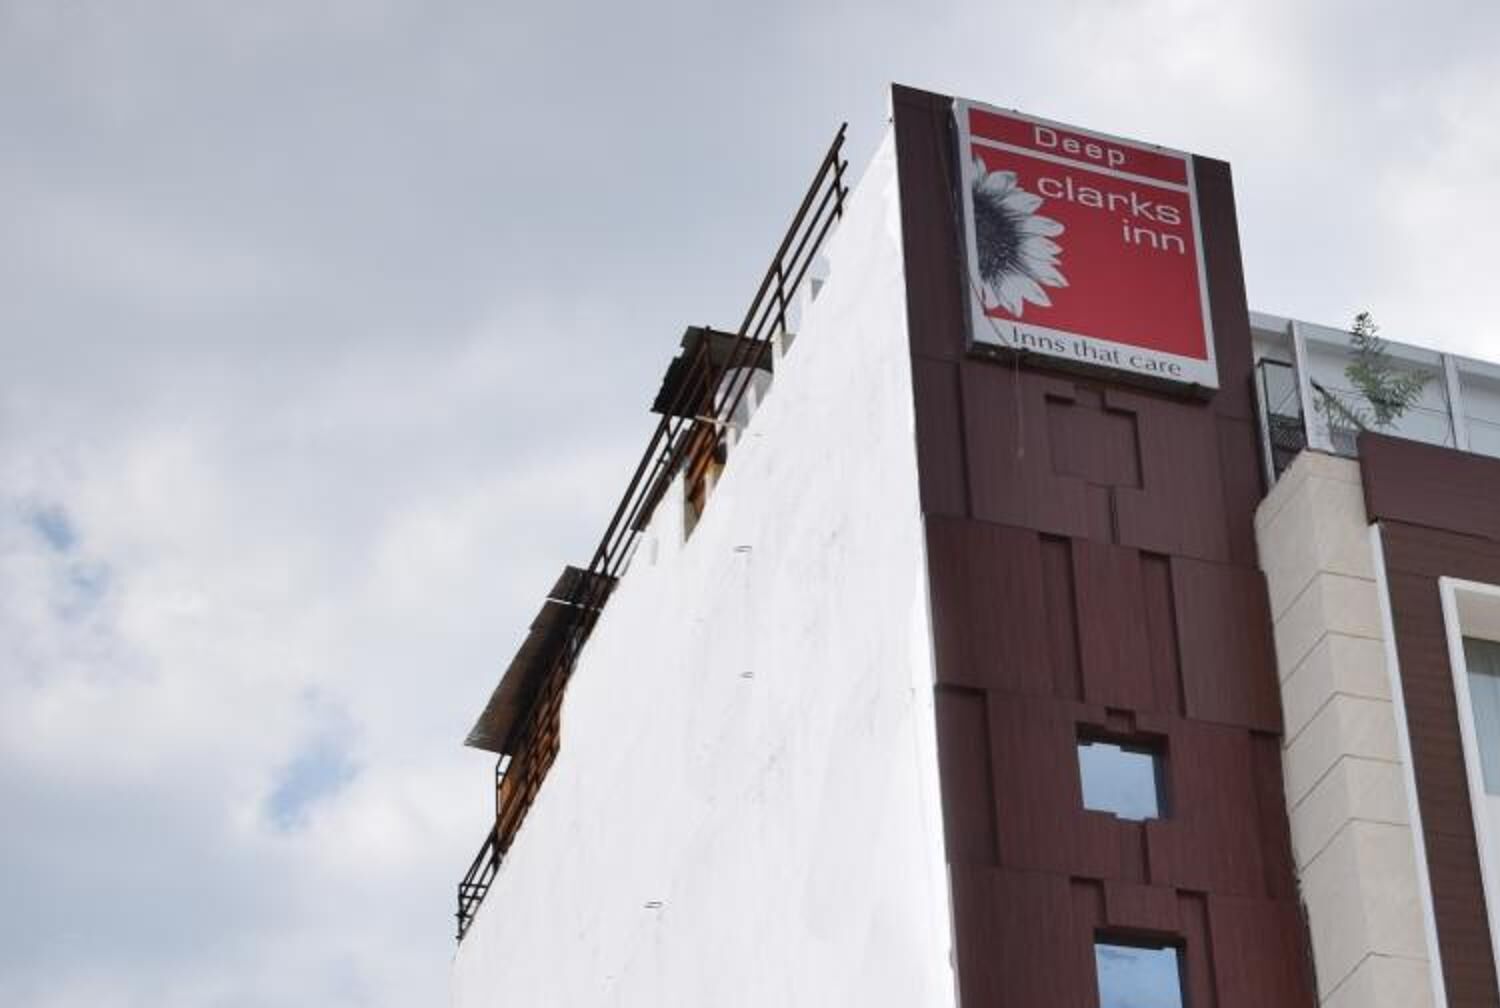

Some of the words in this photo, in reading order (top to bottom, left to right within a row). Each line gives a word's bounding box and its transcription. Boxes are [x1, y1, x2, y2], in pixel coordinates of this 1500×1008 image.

[1034, 126, 1124, 166] Deep
[1037, 176, 1181, 225] clarks
[1122, 218, 1185, 254] inn
[1012, 326, 1065, 352] Inns
[1073, 339, 1119, 364] that
[1129, 354, 1182, 376] care
